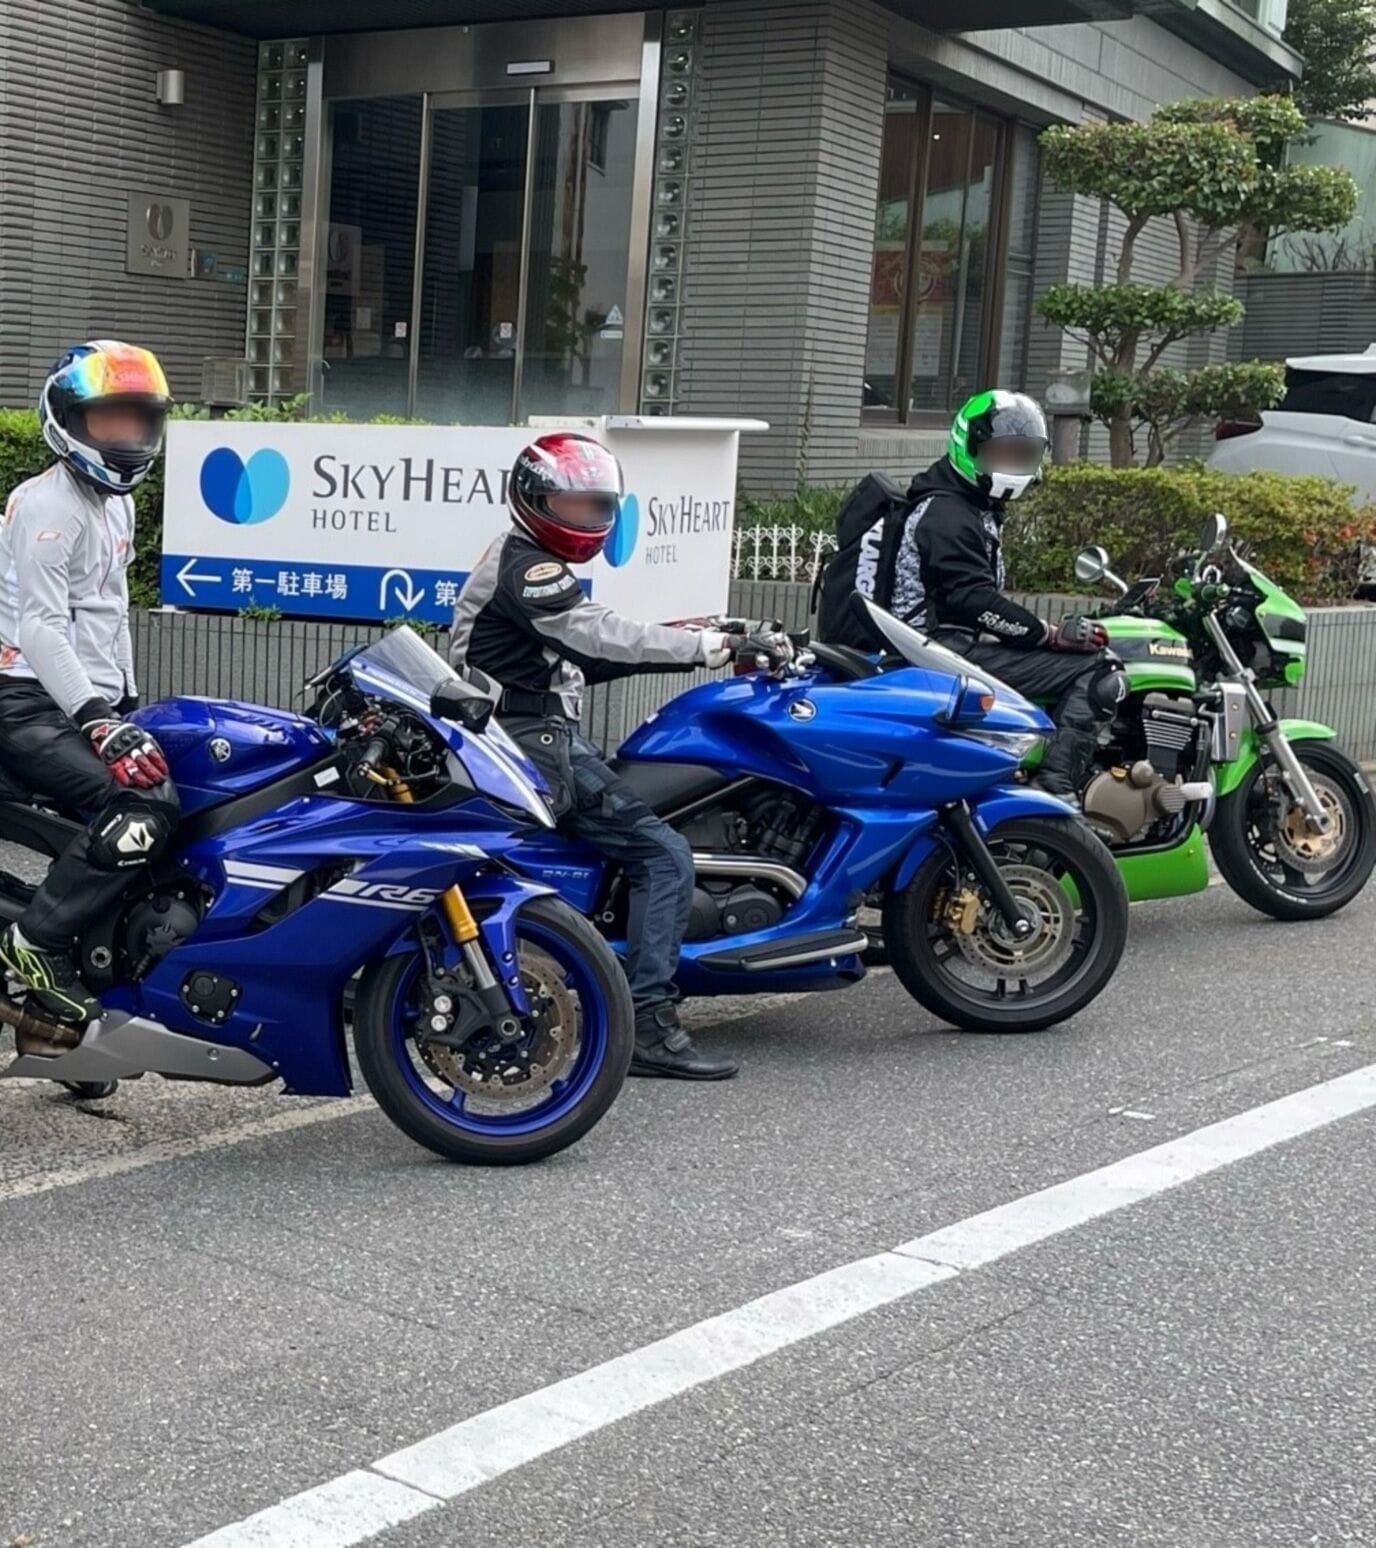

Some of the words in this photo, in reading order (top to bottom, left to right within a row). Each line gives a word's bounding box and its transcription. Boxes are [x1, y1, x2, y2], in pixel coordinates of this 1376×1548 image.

[311, 508, 397, 533] HOTEL
[645, 544, 678, 565] HOTEL
[855, 517, 885, 601] LARG
[231, 567, 349, 600] 第一駐車場
[434, 579, 458, 607] 第
[358, 883, 443, 905] R6
